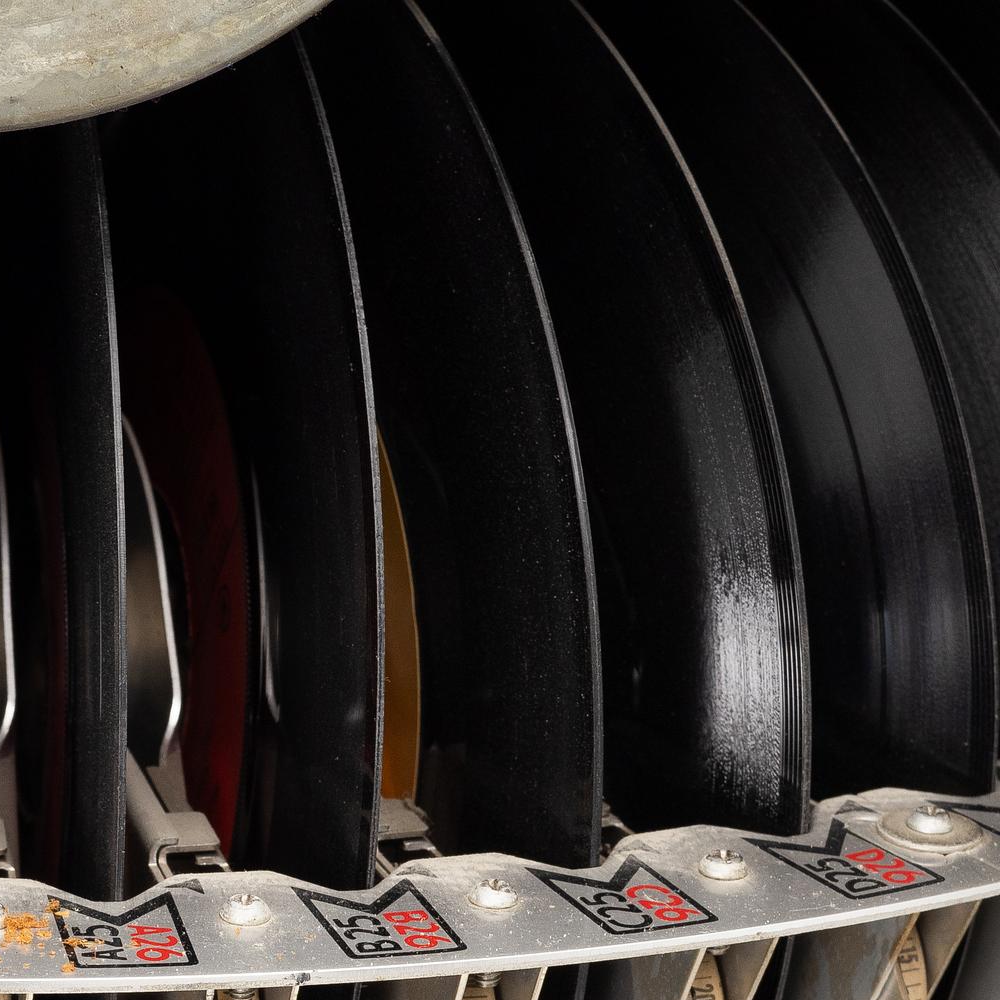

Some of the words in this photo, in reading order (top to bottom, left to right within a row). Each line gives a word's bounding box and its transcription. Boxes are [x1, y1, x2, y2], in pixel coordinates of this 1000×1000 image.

[803, 857, 891, 893] D25
[845, 847, 925, 884] D26
[578, 891, 654, 929] C25
[626, 885, 702, 923] C26
[72, 924, 127, 961] A25
[127, 924, 183, 963] A26
[333, 915, 401, 954] B25
[384, 910, 452, 950] B26
